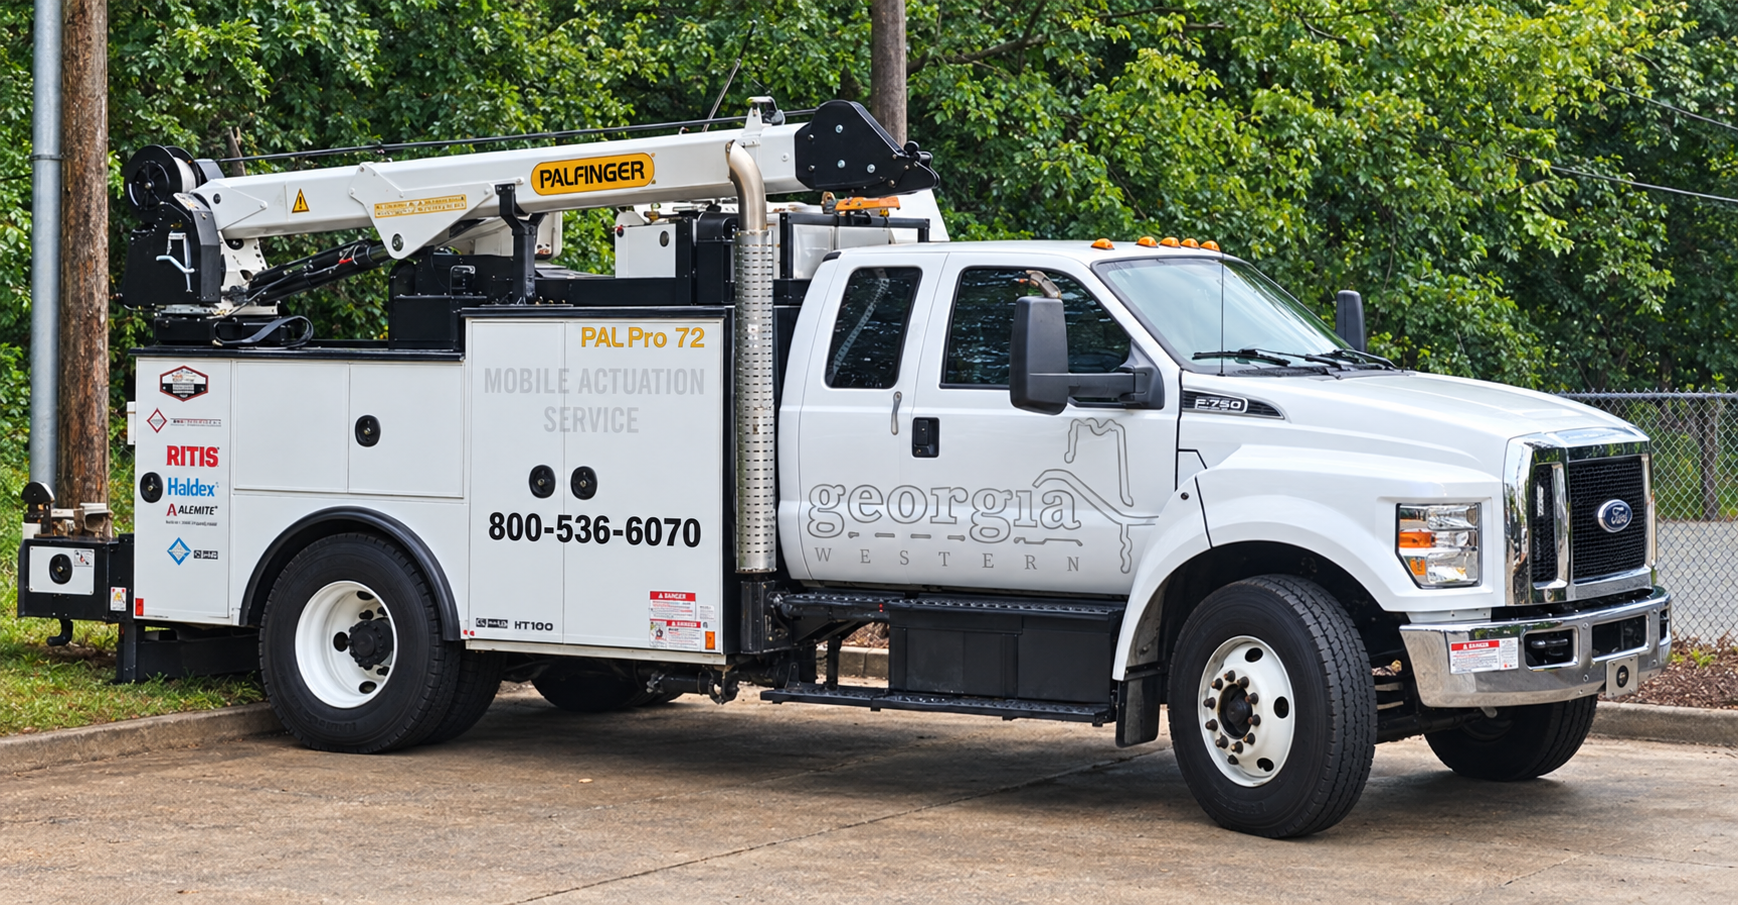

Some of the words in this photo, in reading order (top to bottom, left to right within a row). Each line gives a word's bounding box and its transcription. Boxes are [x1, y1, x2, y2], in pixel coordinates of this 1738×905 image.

[540, 160, 645, 189] PALFINGER
[675, 327, 705, 348] 72
[484, 367, 569, 394] MOBILE
[578, 368, 705, 395] ACTUATION
[543, 406, 640, 433] SERVICE
[166, 445, 219, 468] RITIS
[167, 477, 216, 497] Haldex
[178, 505, 215, 516] ALEMITE
[807, 484, 1082, 543] georgia
[489, 511, 702, 548] 800-536-6070
[814, 547, 1081, 573] WESTERN
[514, 620, 554, 631] HT100
